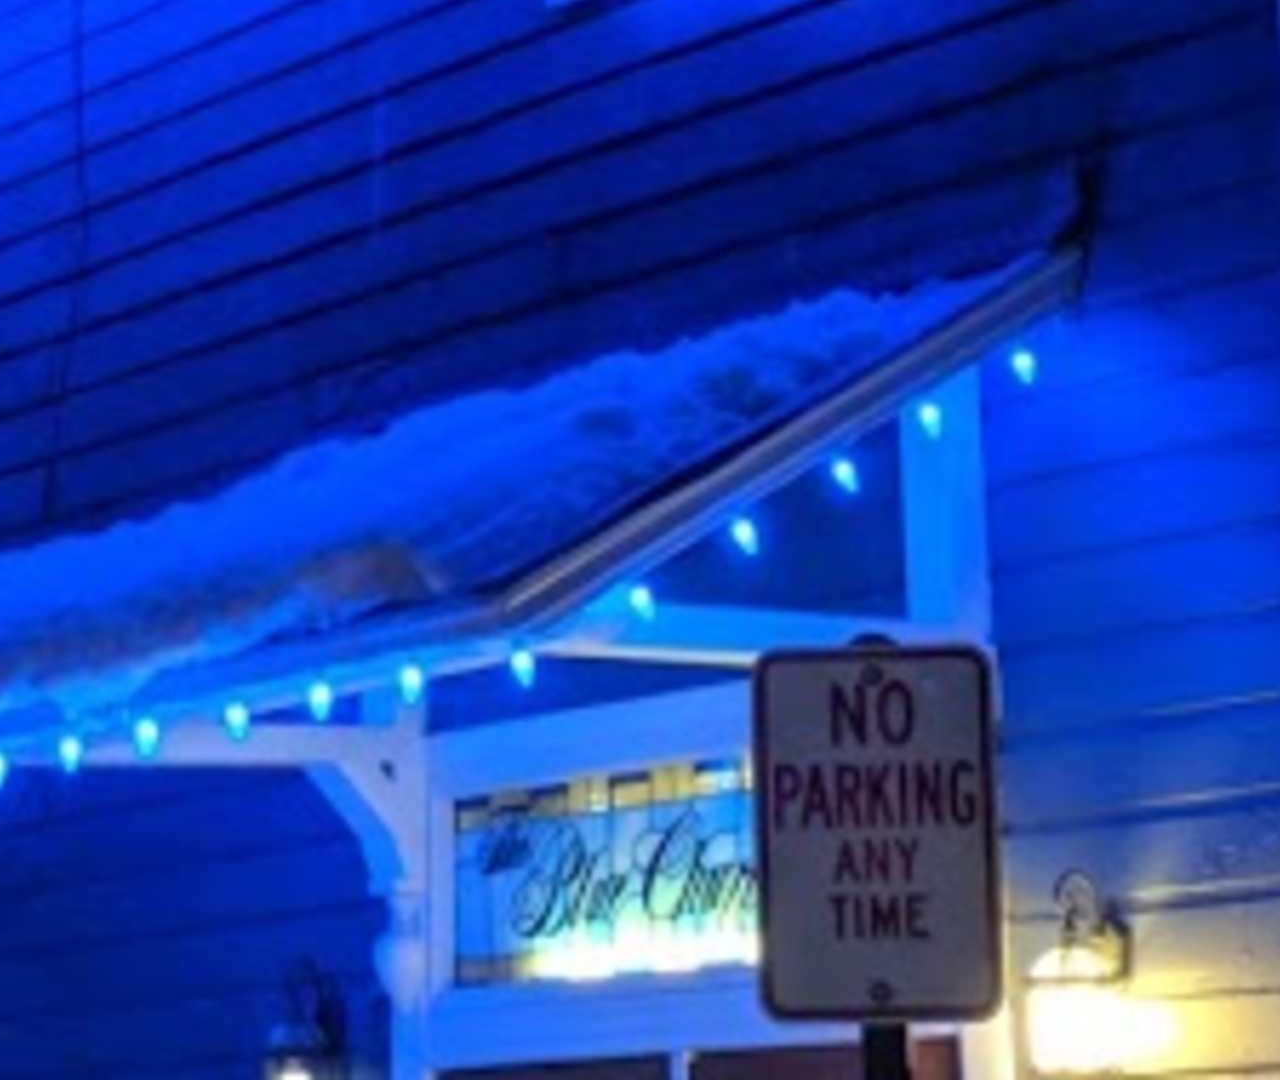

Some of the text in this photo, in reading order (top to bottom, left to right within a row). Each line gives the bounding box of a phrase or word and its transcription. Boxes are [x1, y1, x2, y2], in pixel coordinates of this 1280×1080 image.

[828, 680, 914, 748] NO
[773, 760, 976, 831] PARKING
[511, 821, 628, 938] Blue
[633, 807, 757, 922] Chur
[832, 838, 919, 885] ANY
[829, 895, 930, 941] TIME
